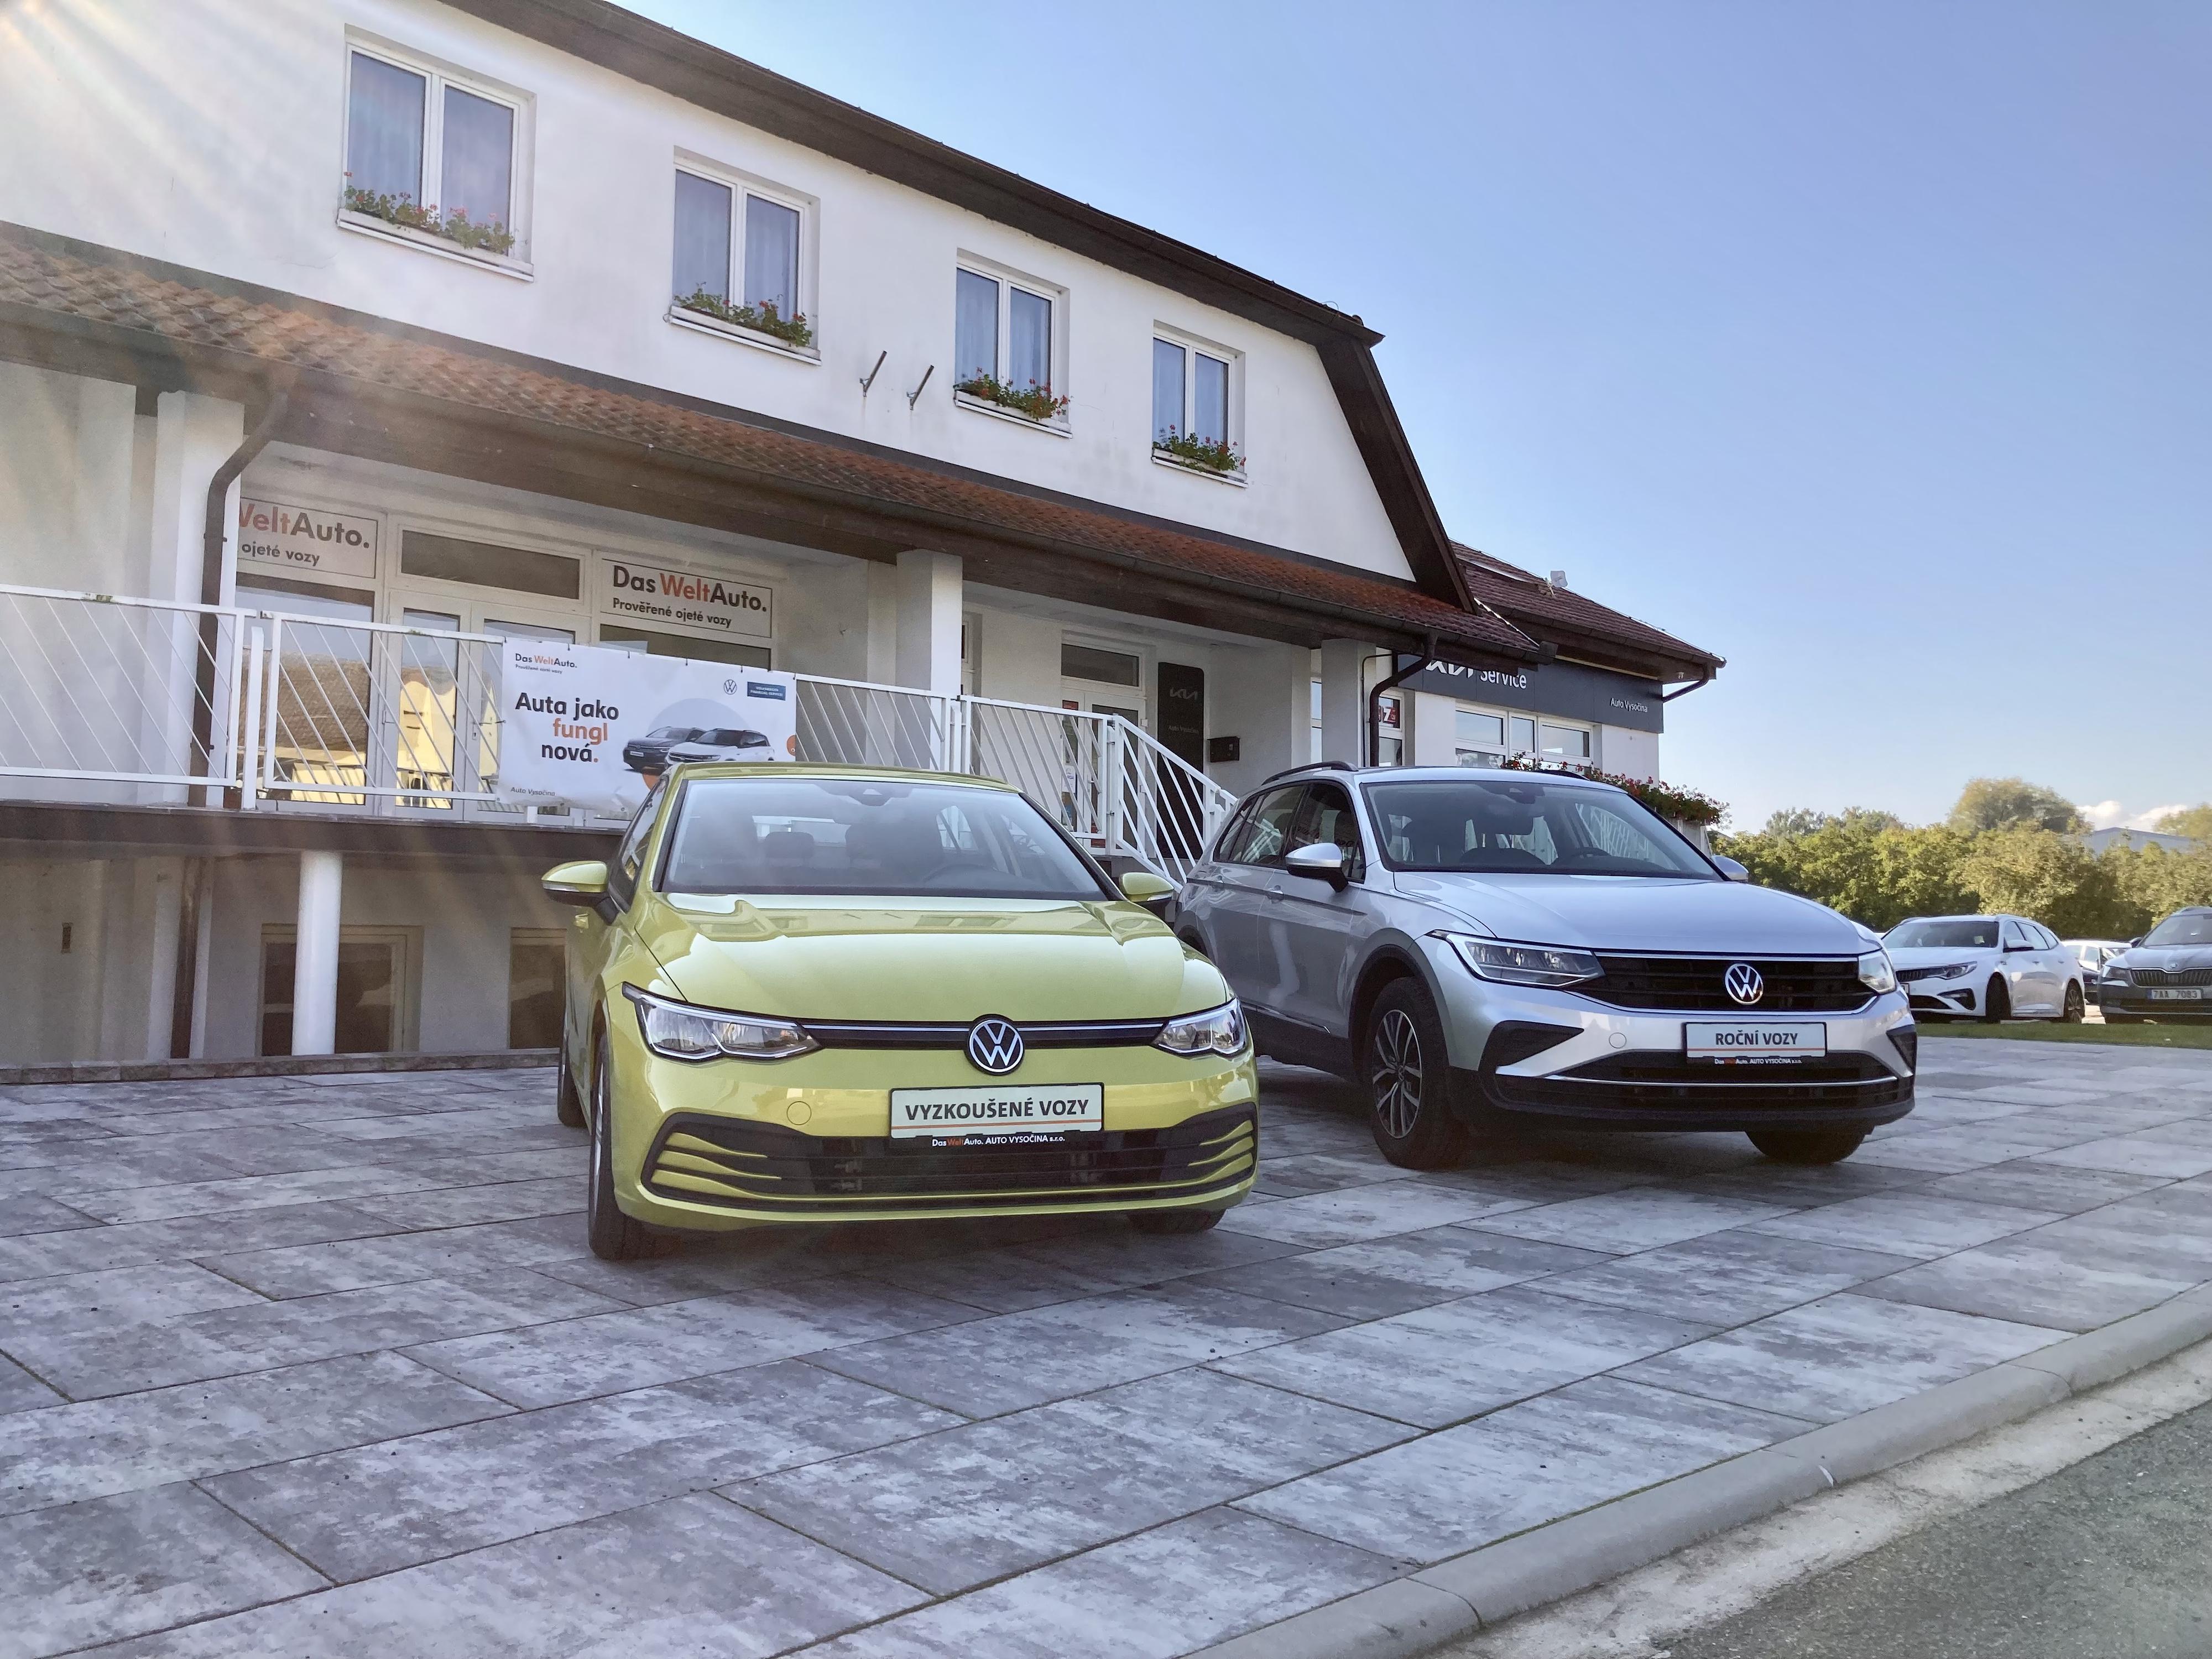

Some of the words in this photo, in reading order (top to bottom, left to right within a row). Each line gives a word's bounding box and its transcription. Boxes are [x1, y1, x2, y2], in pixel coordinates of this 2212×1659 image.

[242, 541, 280, 557] ojeté
[286, 550, 320, 566] vozy
[613, 565, 656, 593] Das
[660, 573, 766, 612] WeltAuto.
[613, 598, 671, 617] Prověřené
[676, 608, 703, 622] ojeté
[707, 615, 732, 628] vozy
[515, 653, 533, 662] Das
[534, 655, 577, 668] WeltAuto.
[515, 692, 567, 715] Auta
[573, 697, 619, 721] jako
[1610, 697, 1624, 708] Auto
[553, 718, 608, 745] fungl
[542, 743, 598, 763] nová.
[1715, 1030, 1759, 1045] ROČNÍ
[1762, 1033, 1798, 1045] VOZY
[906, 1098, 1033, 1120] VYZKOUŠENÉ
[1039, 1099, 1089, 1115] VOZY
[1009, 1135, 1048, 1143] VYSOČINA
